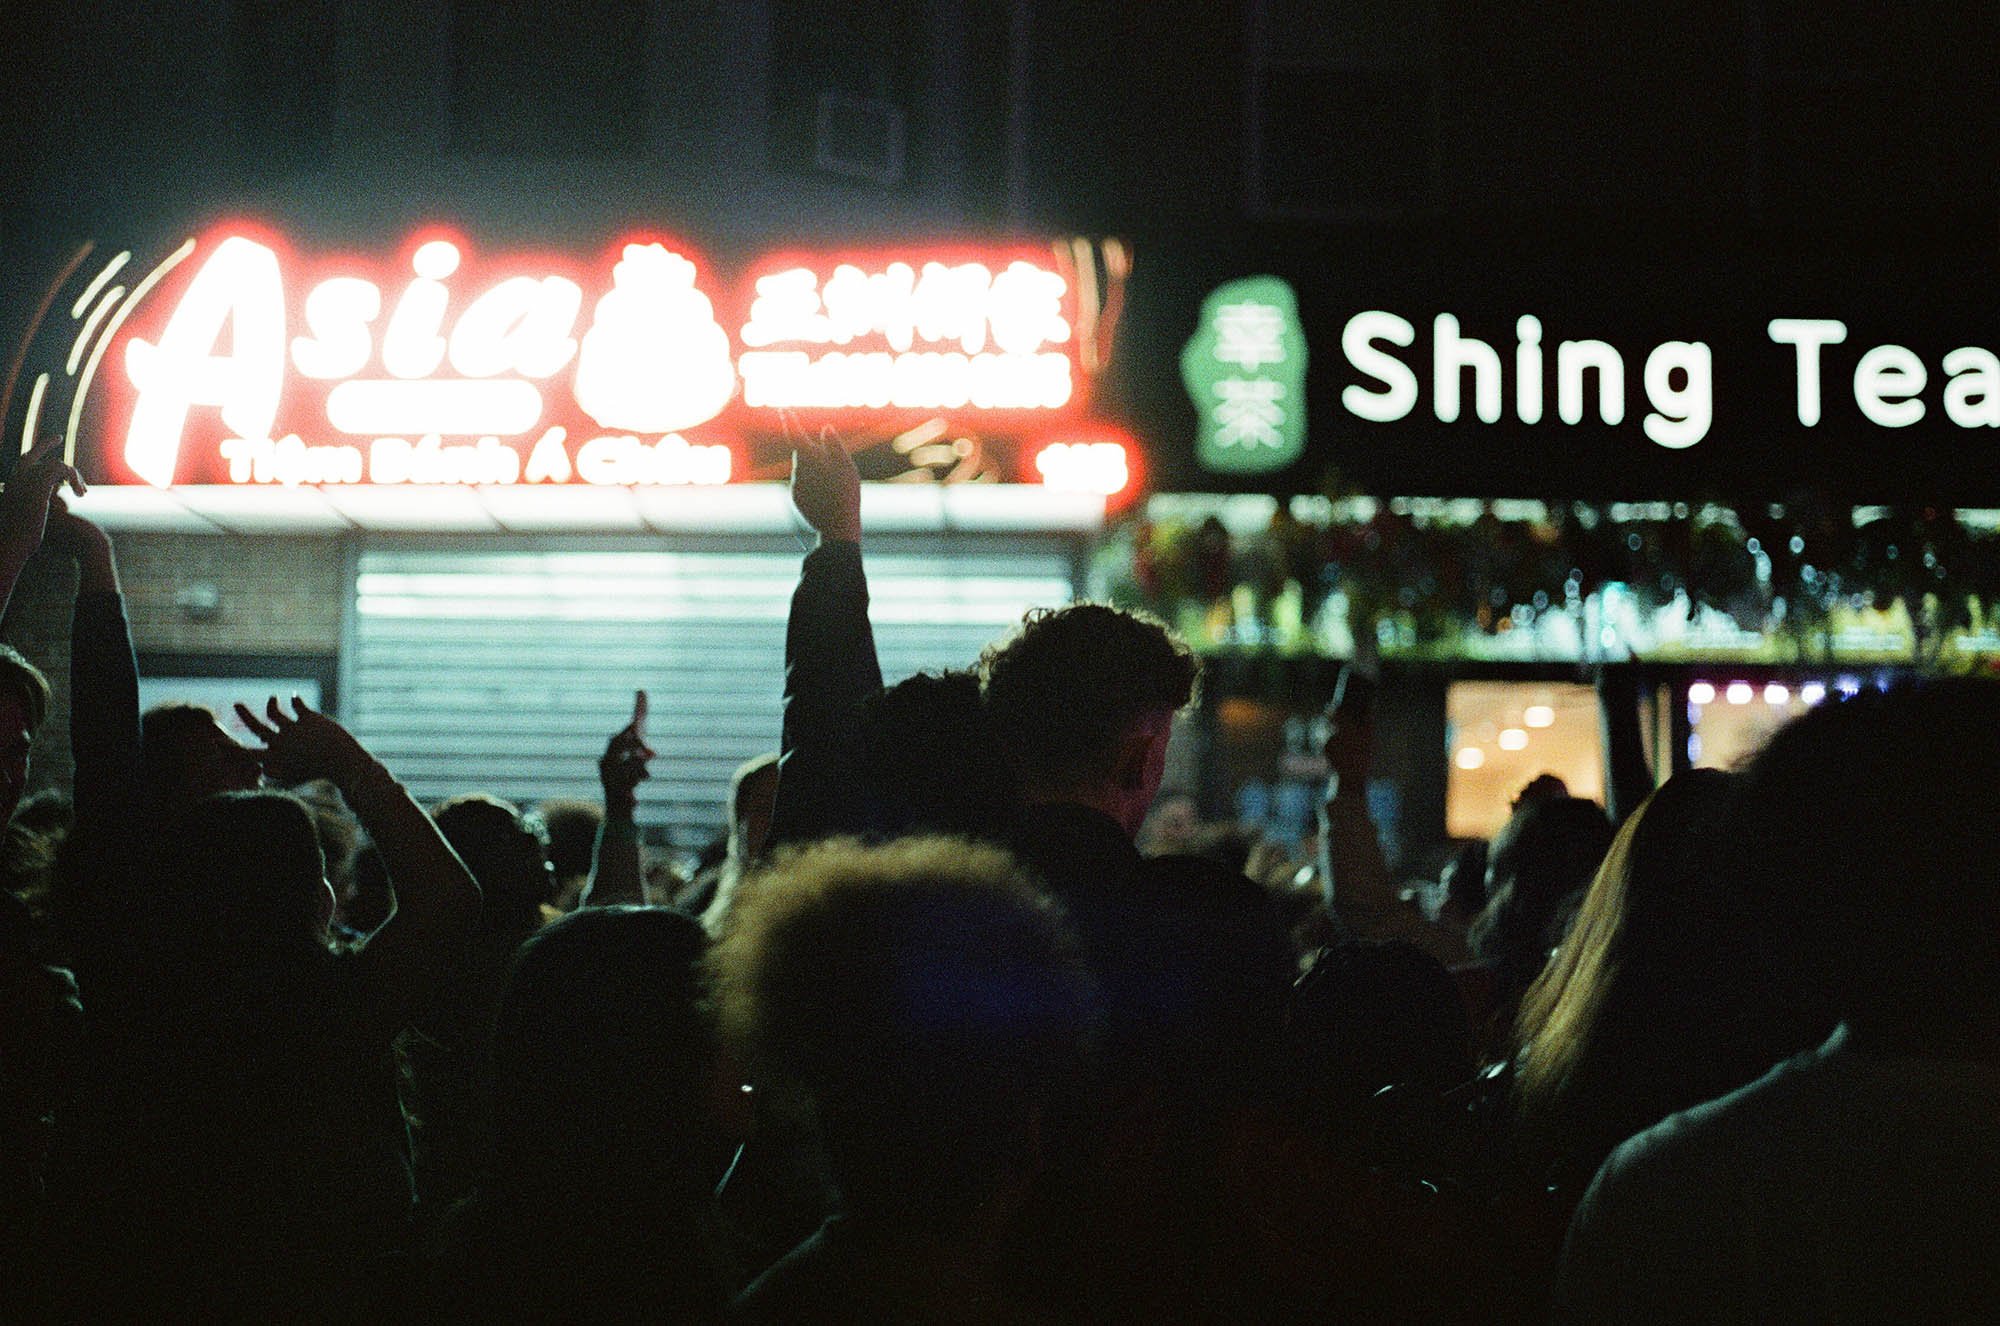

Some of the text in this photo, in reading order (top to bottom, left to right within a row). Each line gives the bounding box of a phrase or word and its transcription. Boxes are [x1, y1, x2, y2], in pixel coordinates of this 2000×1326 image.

[125, 236, 583, 489] Asia
[1342, 311, 2000, 448] Shing Tea
